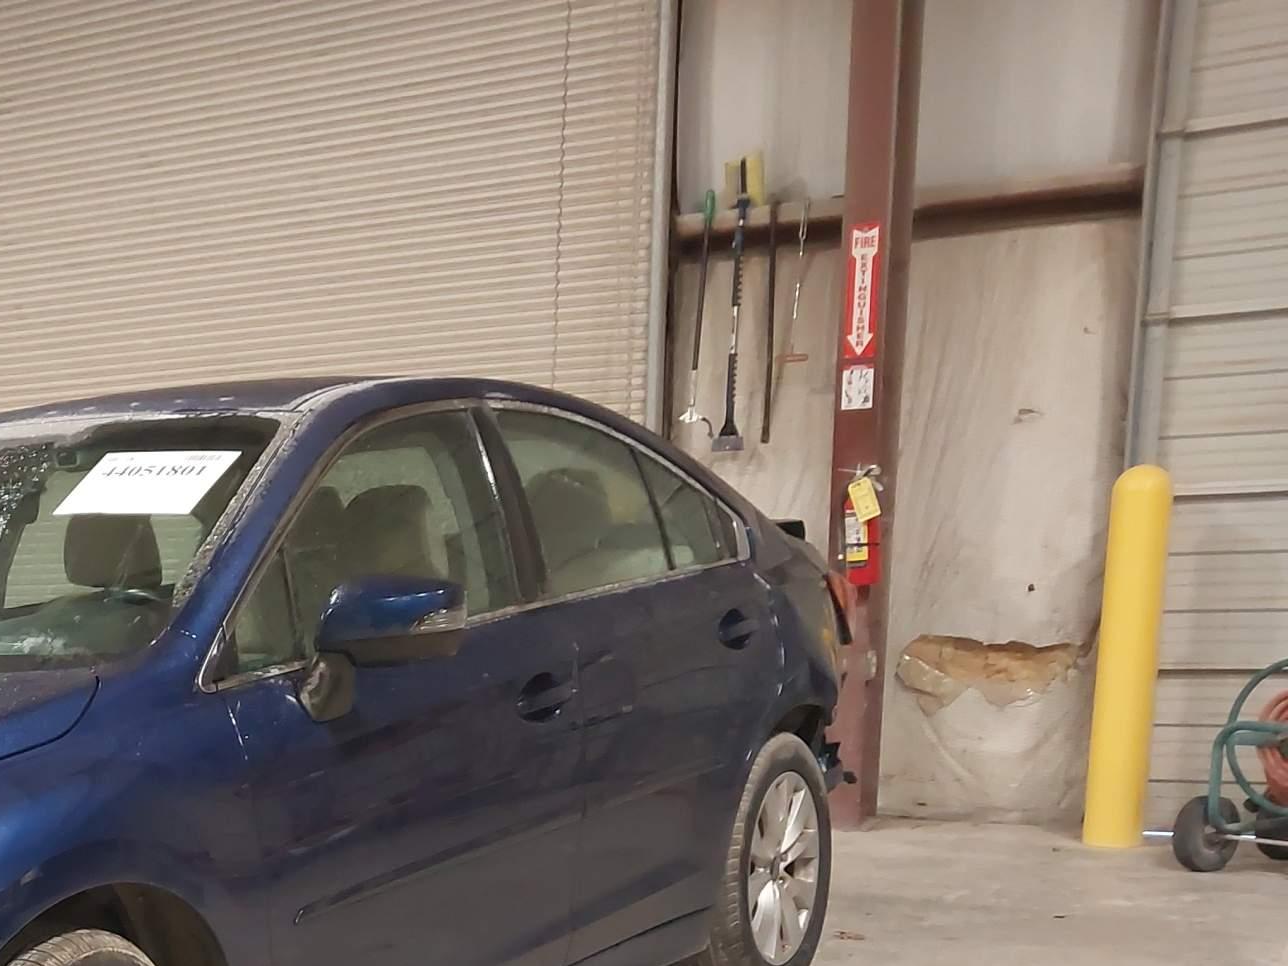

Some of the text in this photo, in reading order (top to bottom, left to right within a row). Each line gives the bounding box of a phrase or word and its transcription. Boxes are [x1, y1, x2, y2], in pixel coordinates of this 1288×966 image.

[854, 236, 876, 249] FIRE
[855, 253, 868, 347] EXTINGUISHER
[101, 464, 208, 477] 44051801
